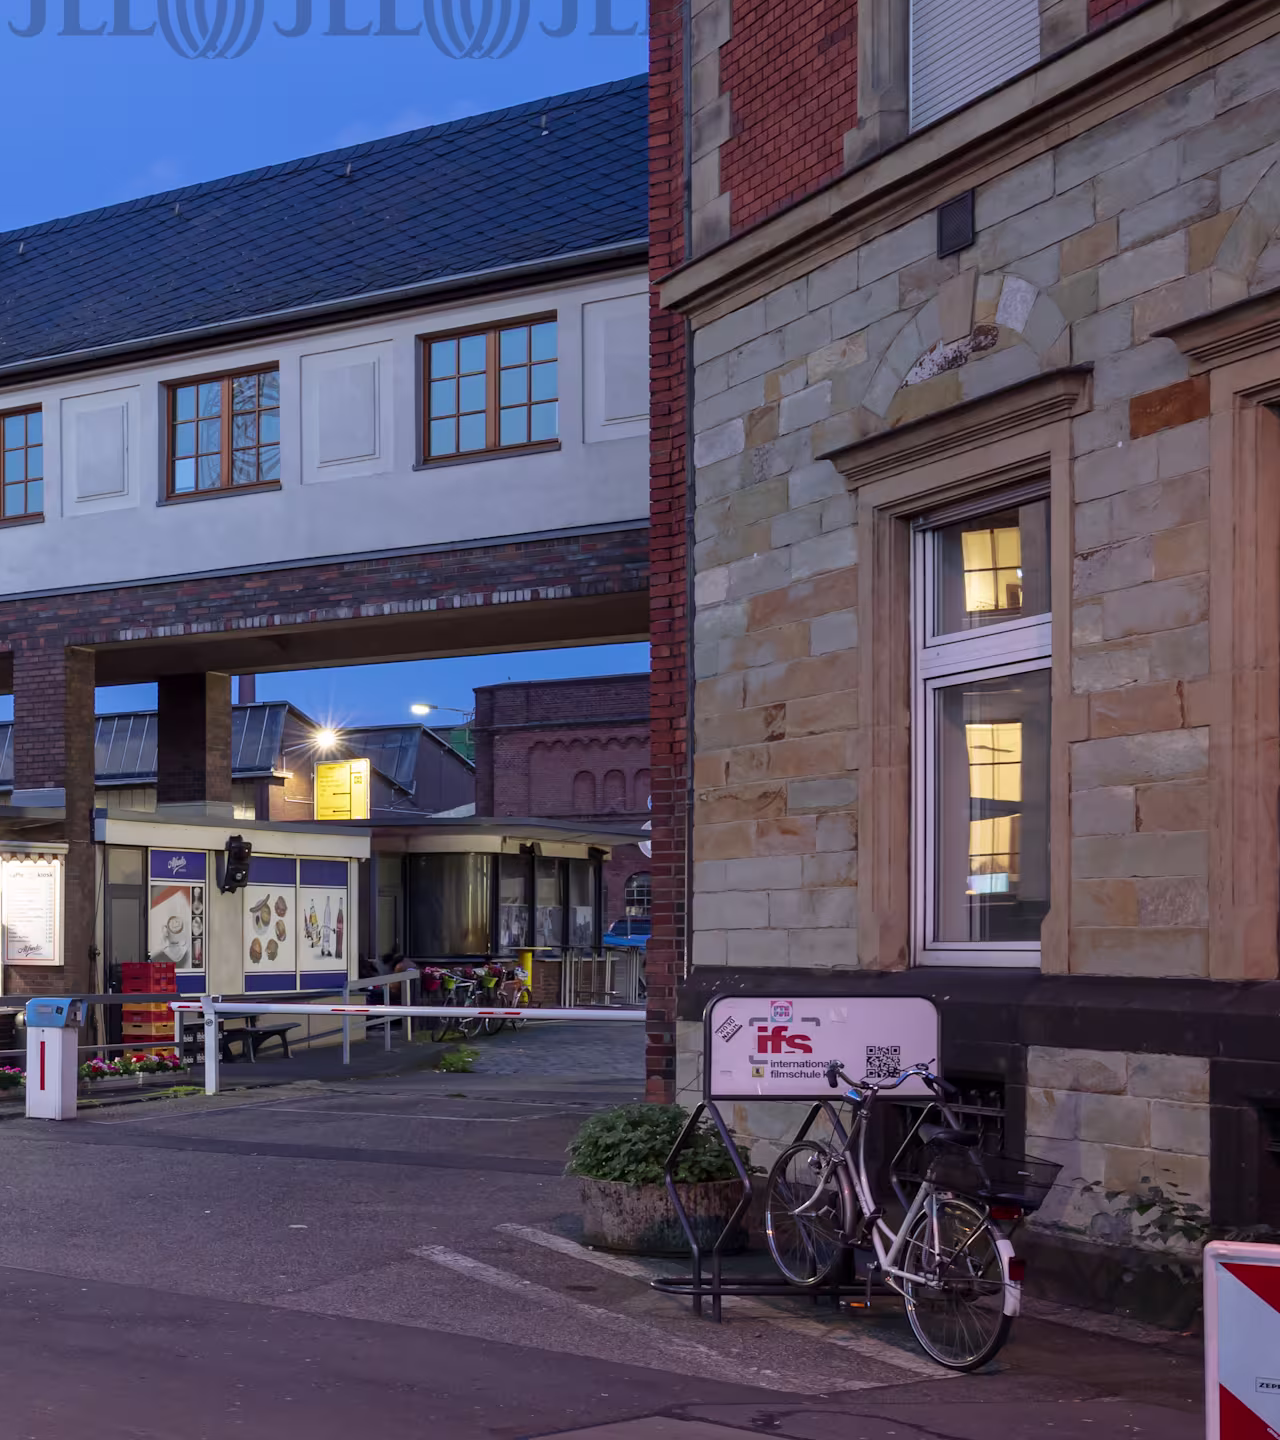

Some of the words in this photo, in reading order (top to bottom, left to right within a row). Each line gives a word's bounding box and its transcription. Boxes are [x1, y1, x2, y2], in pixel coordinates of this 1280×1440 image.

[757, 1025, 813, 1054] ifs
[770, 1060, 833, 1069] international
[770, 1070, 821, 1079] filmschule
